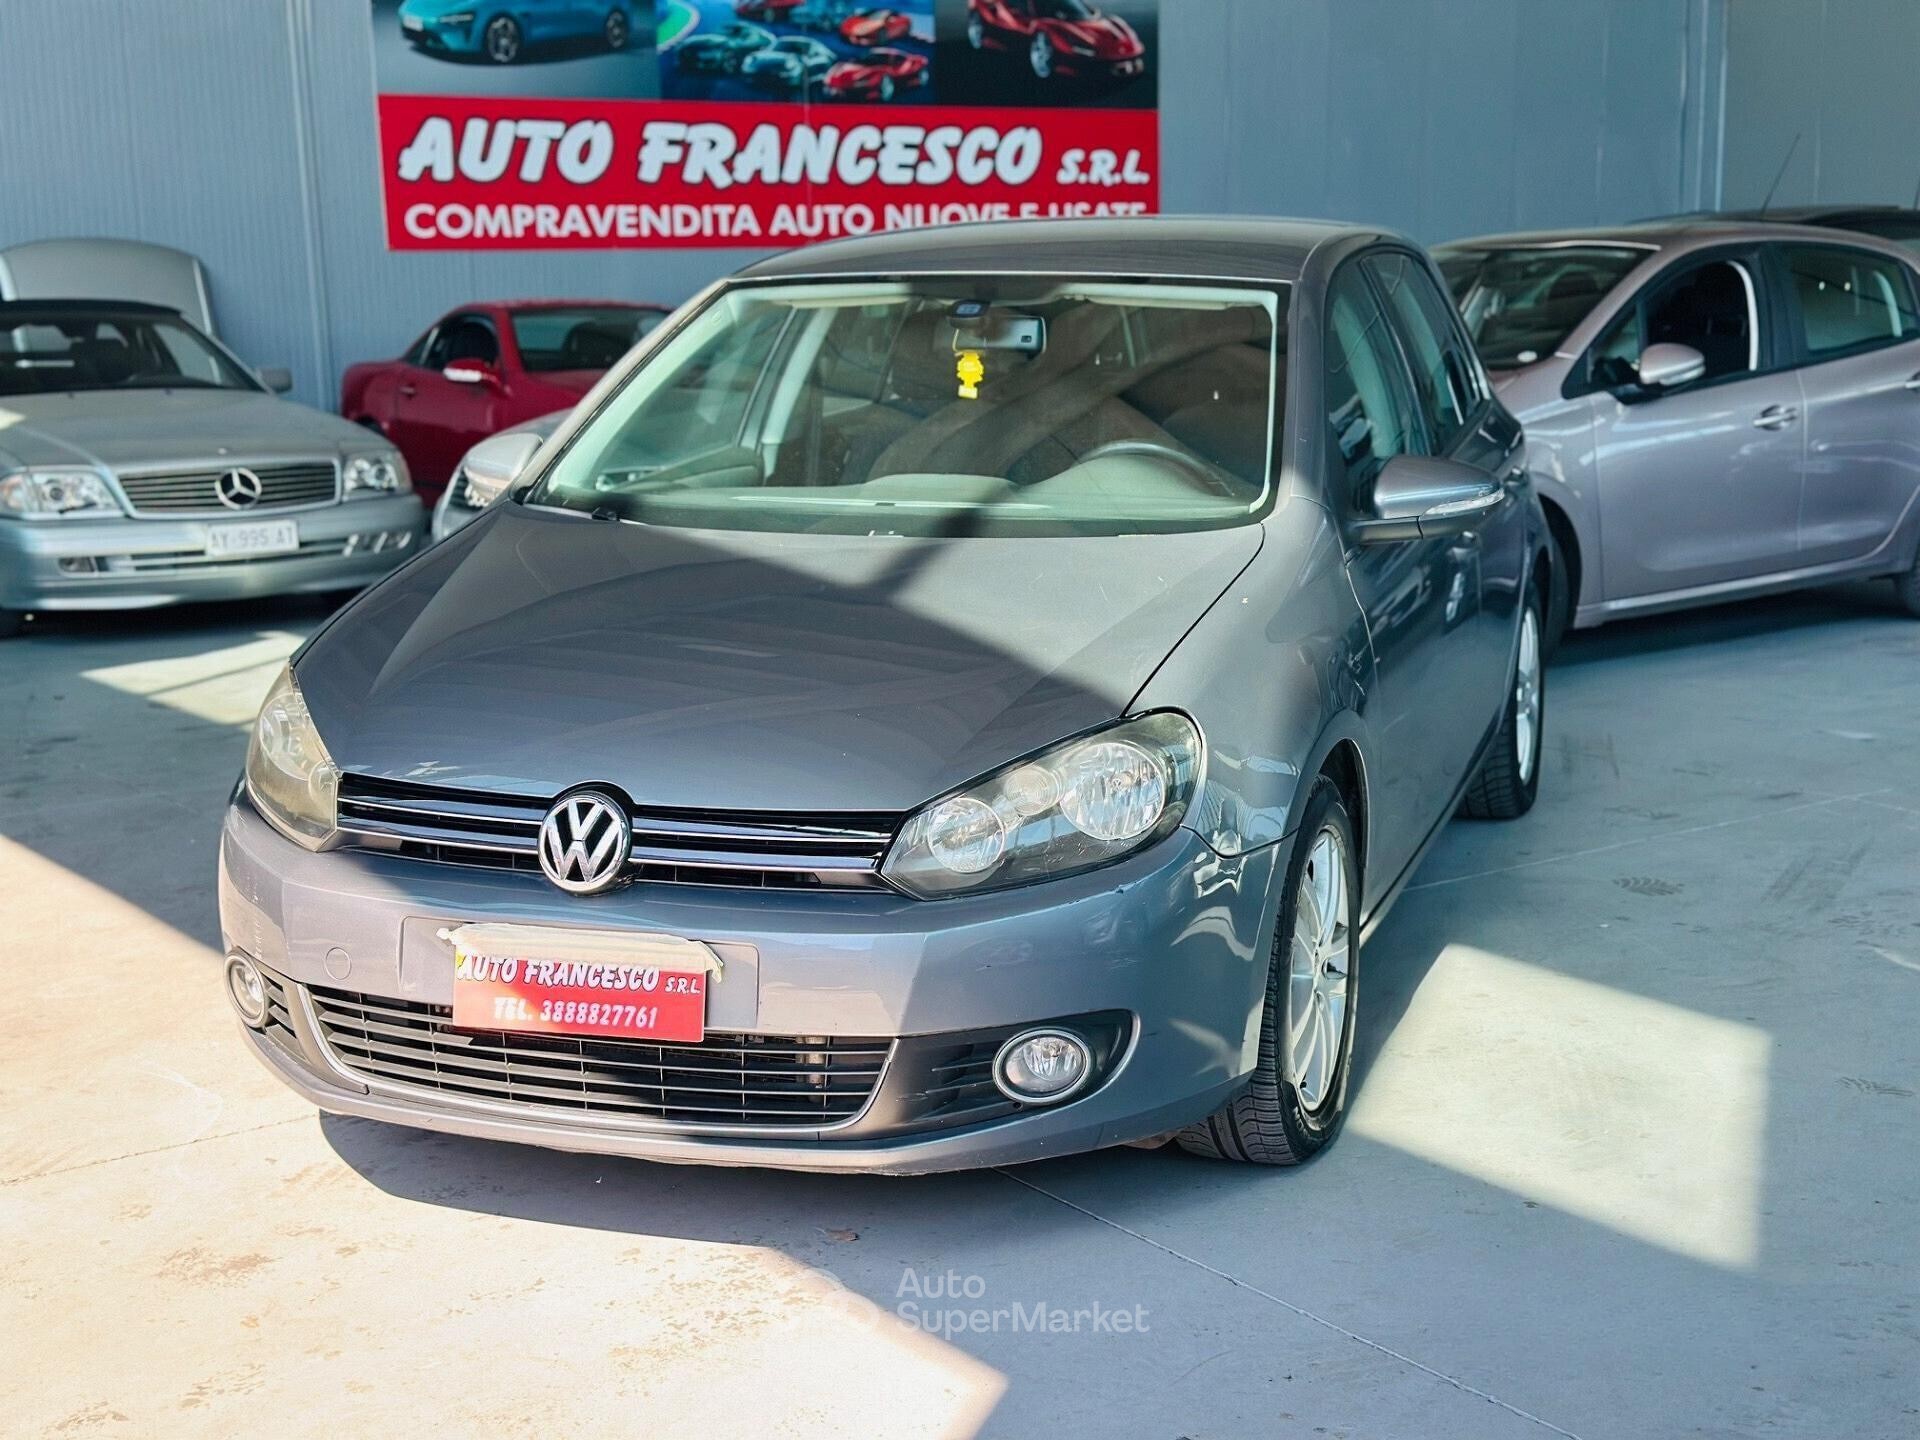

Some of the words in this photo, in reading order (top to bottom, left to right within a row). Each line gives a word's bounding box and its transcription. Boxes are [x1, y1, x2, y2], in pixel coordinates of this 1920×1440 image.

[398, 116, 614, 185] AUTO
[637, 121, 1043, 189] FRANCESCO
[404, 203, 762, 238] COMPRAVENDITA
[769, 203, 875, 237] AUTO
[457, 953, 518, 983] AUTO
[523, 959, 660, 991] FRANCESCO
[495, 996, 532, 1021] TEL.
[540, 1000, 658, 1028] 3888827761
